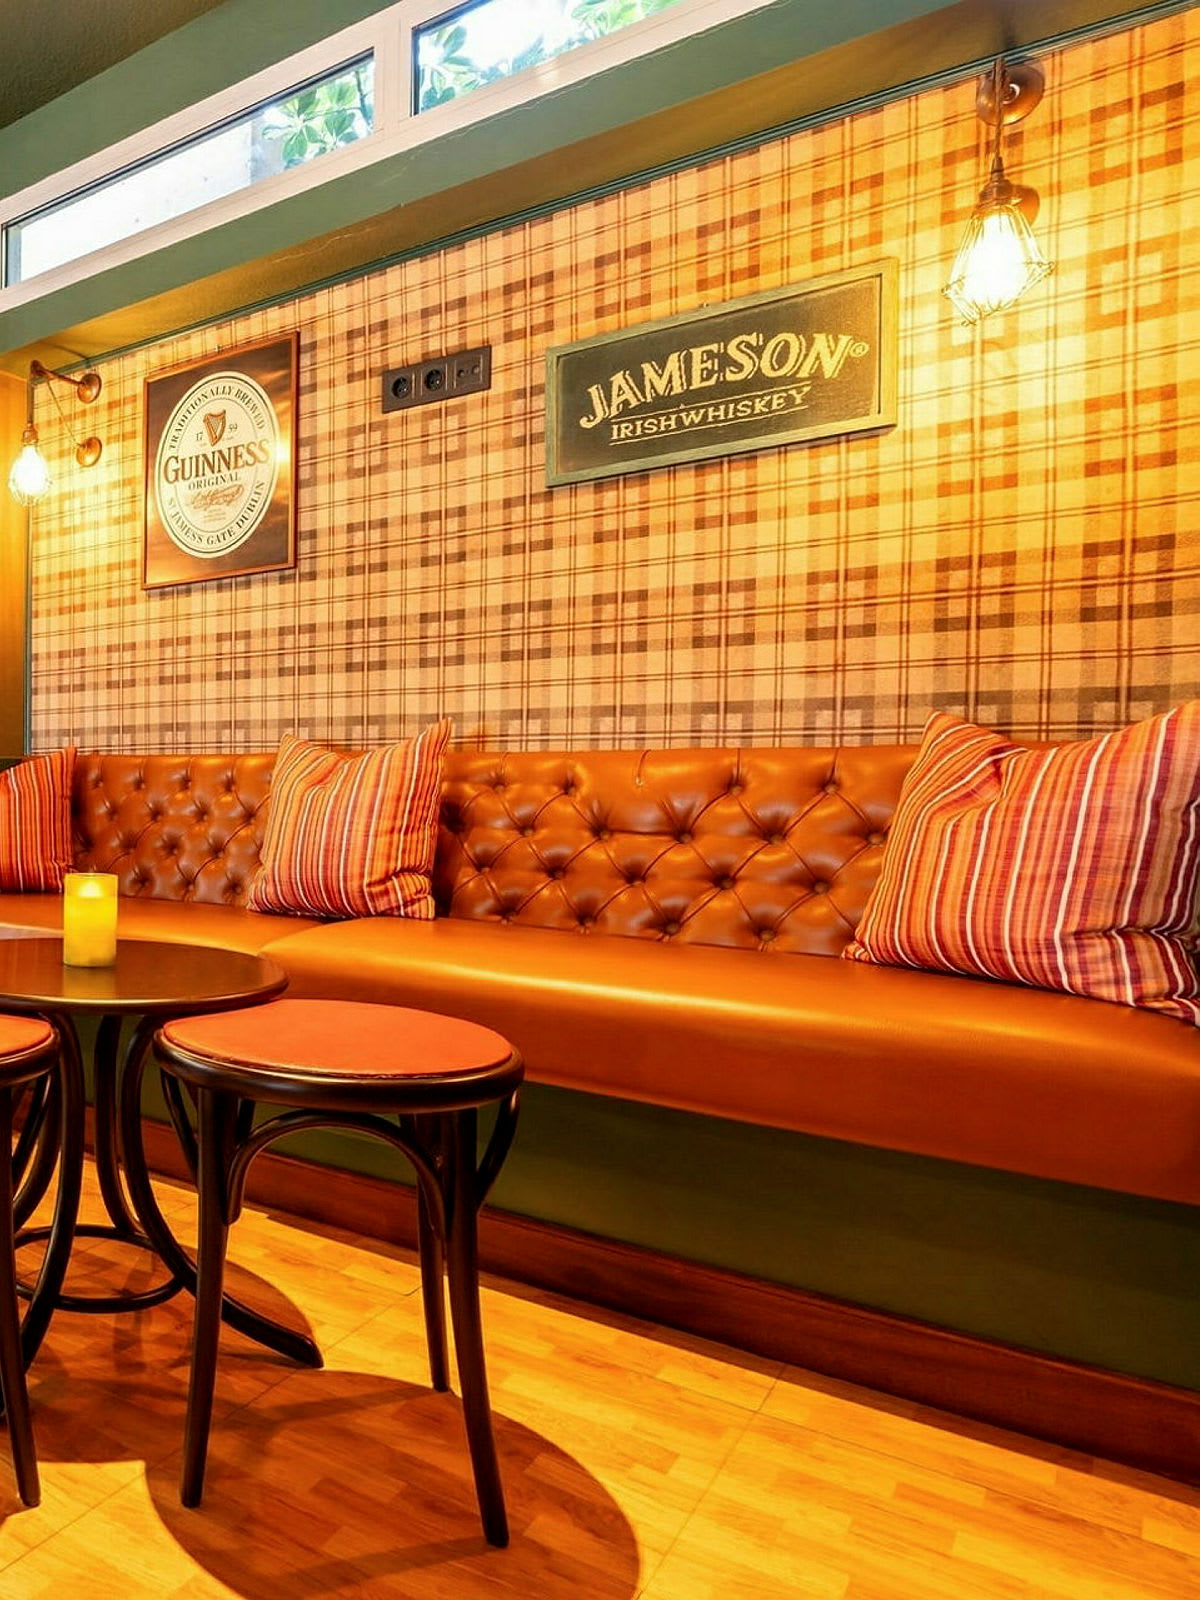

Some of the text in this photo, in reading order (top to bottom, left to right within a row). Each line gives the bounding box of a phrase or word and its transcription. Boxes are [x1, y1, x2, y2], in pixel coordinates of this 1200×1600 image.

[168, 385, 266, 450] TRADITIONALLY BREWED
[610, 385, 812, 441] IRISH WHISKEY
[163, 438, 271, 485] GUINNESS
[188, 471, 242, 491] ORIGINAL
[206, 526, 236, 546] GATE
[236, 480, 267, 530] DUBLIN
